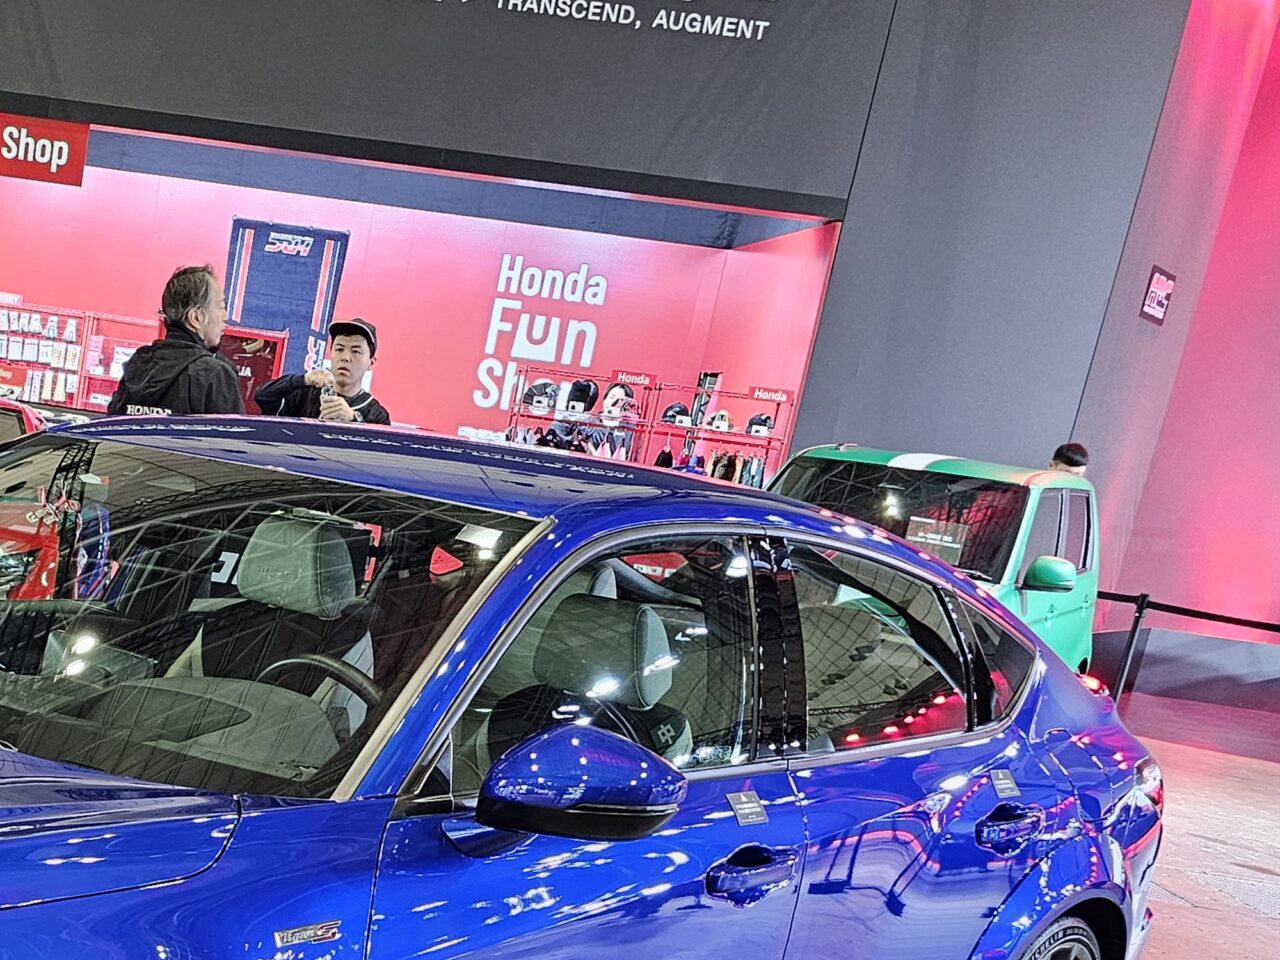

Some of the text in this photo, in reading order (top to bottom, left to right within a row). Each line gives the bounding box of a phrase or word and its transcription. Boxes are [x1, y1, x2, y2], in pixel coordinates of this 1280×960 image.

[652, 9, 770, 41] AUGMENT
[0, 126, 70, 174] Shop
[496, 253, 609, 306] Honda
[483, 297, 599, 368] Fun
[616, 371, 651, 386] Honda
[753, 387, 788, 403] Honda
